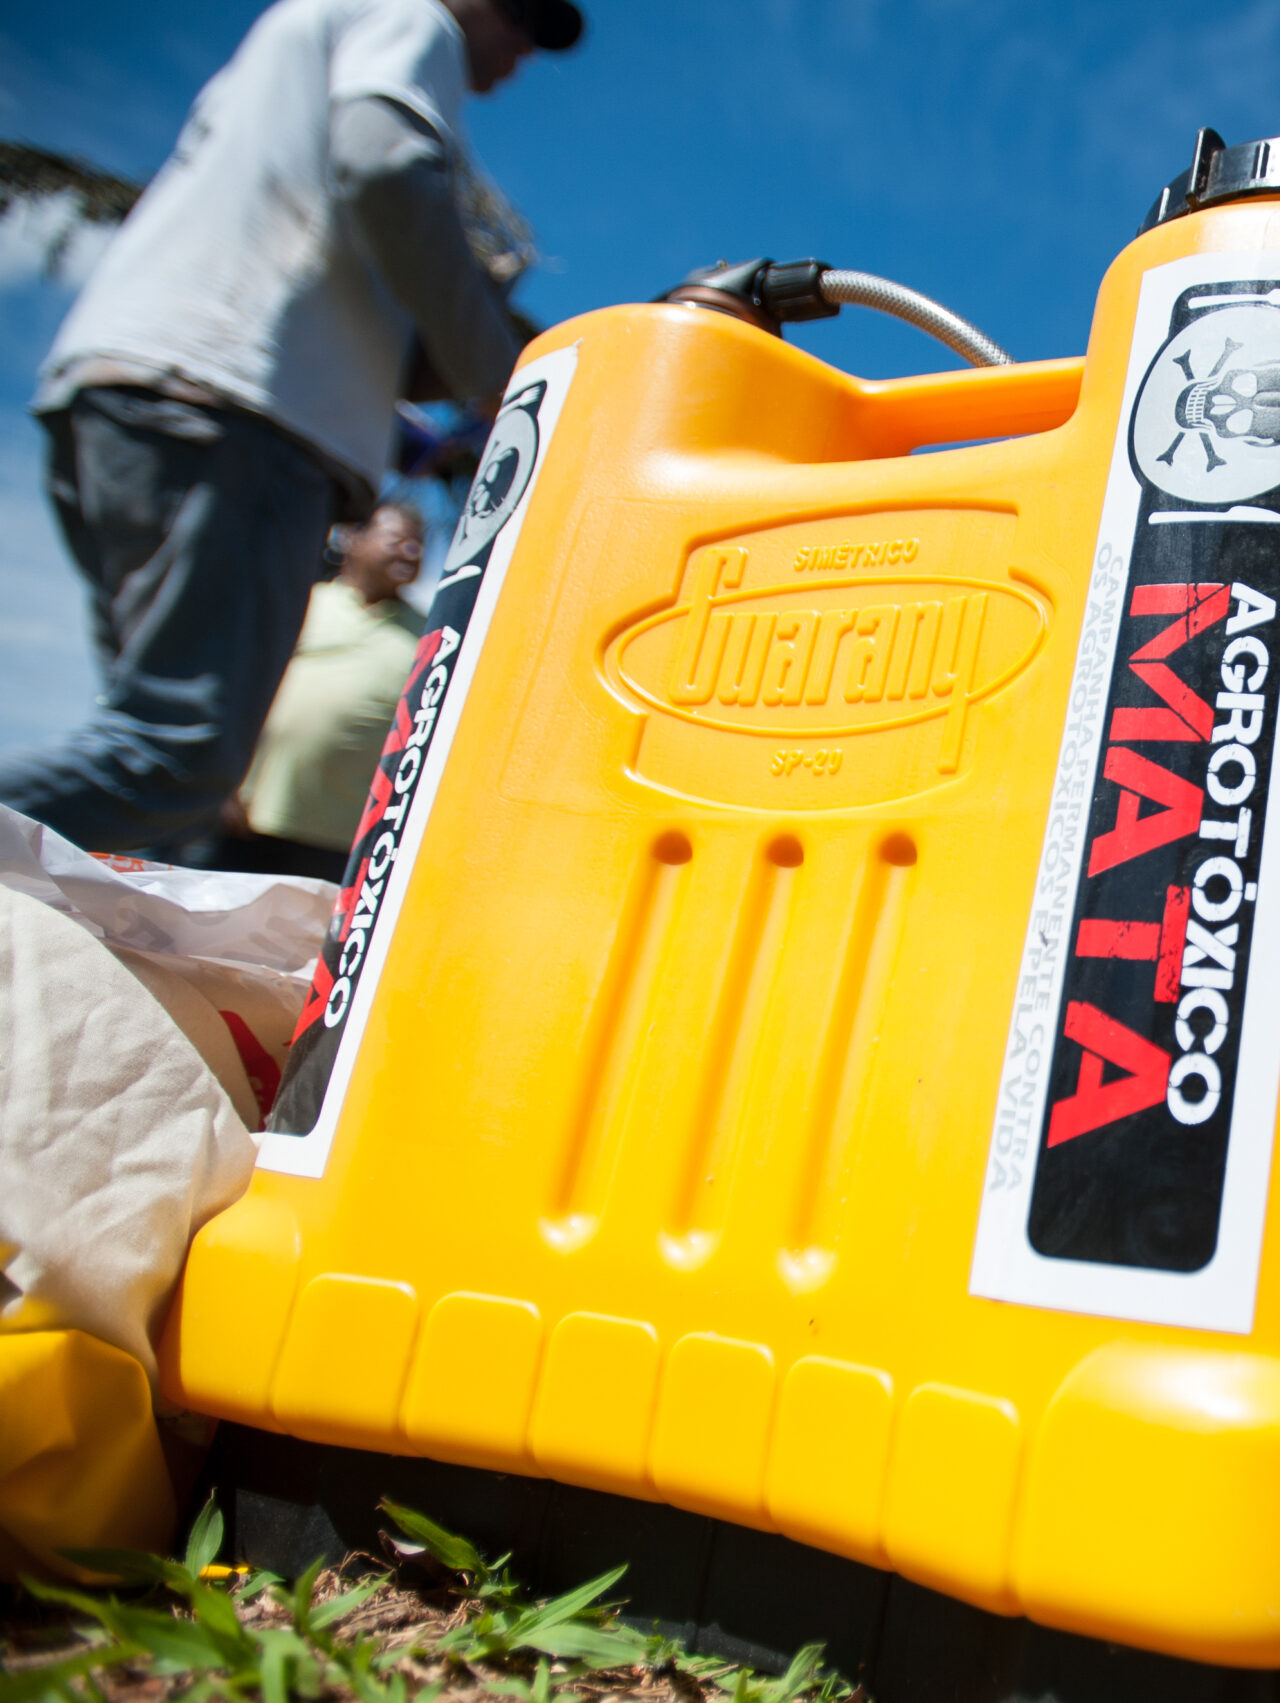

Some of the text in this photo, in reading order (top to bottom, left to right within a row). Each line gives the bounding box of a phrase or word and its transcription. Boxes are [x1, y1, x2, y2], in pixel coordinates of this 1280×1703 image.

[1093, 541, 1113, 590] OS
[668, 546, 988, 775] Guarany
[324, 625, 461, 1029] AGROTÓXICO
[770, 748, 844, 775] SP-20
[1006, 554, 1124, 1191] CAMPANHA PERMANENTE CONTRA
[1032, 910, 1050, 933] E
[1046, 582, 1232, 1149] MATA
[1166, 580, 1276, 1126] AGROTÓXICO
[1008, 947, 1043, 1061] PELA
[988, 1074, 1023, 1194] VIDA
